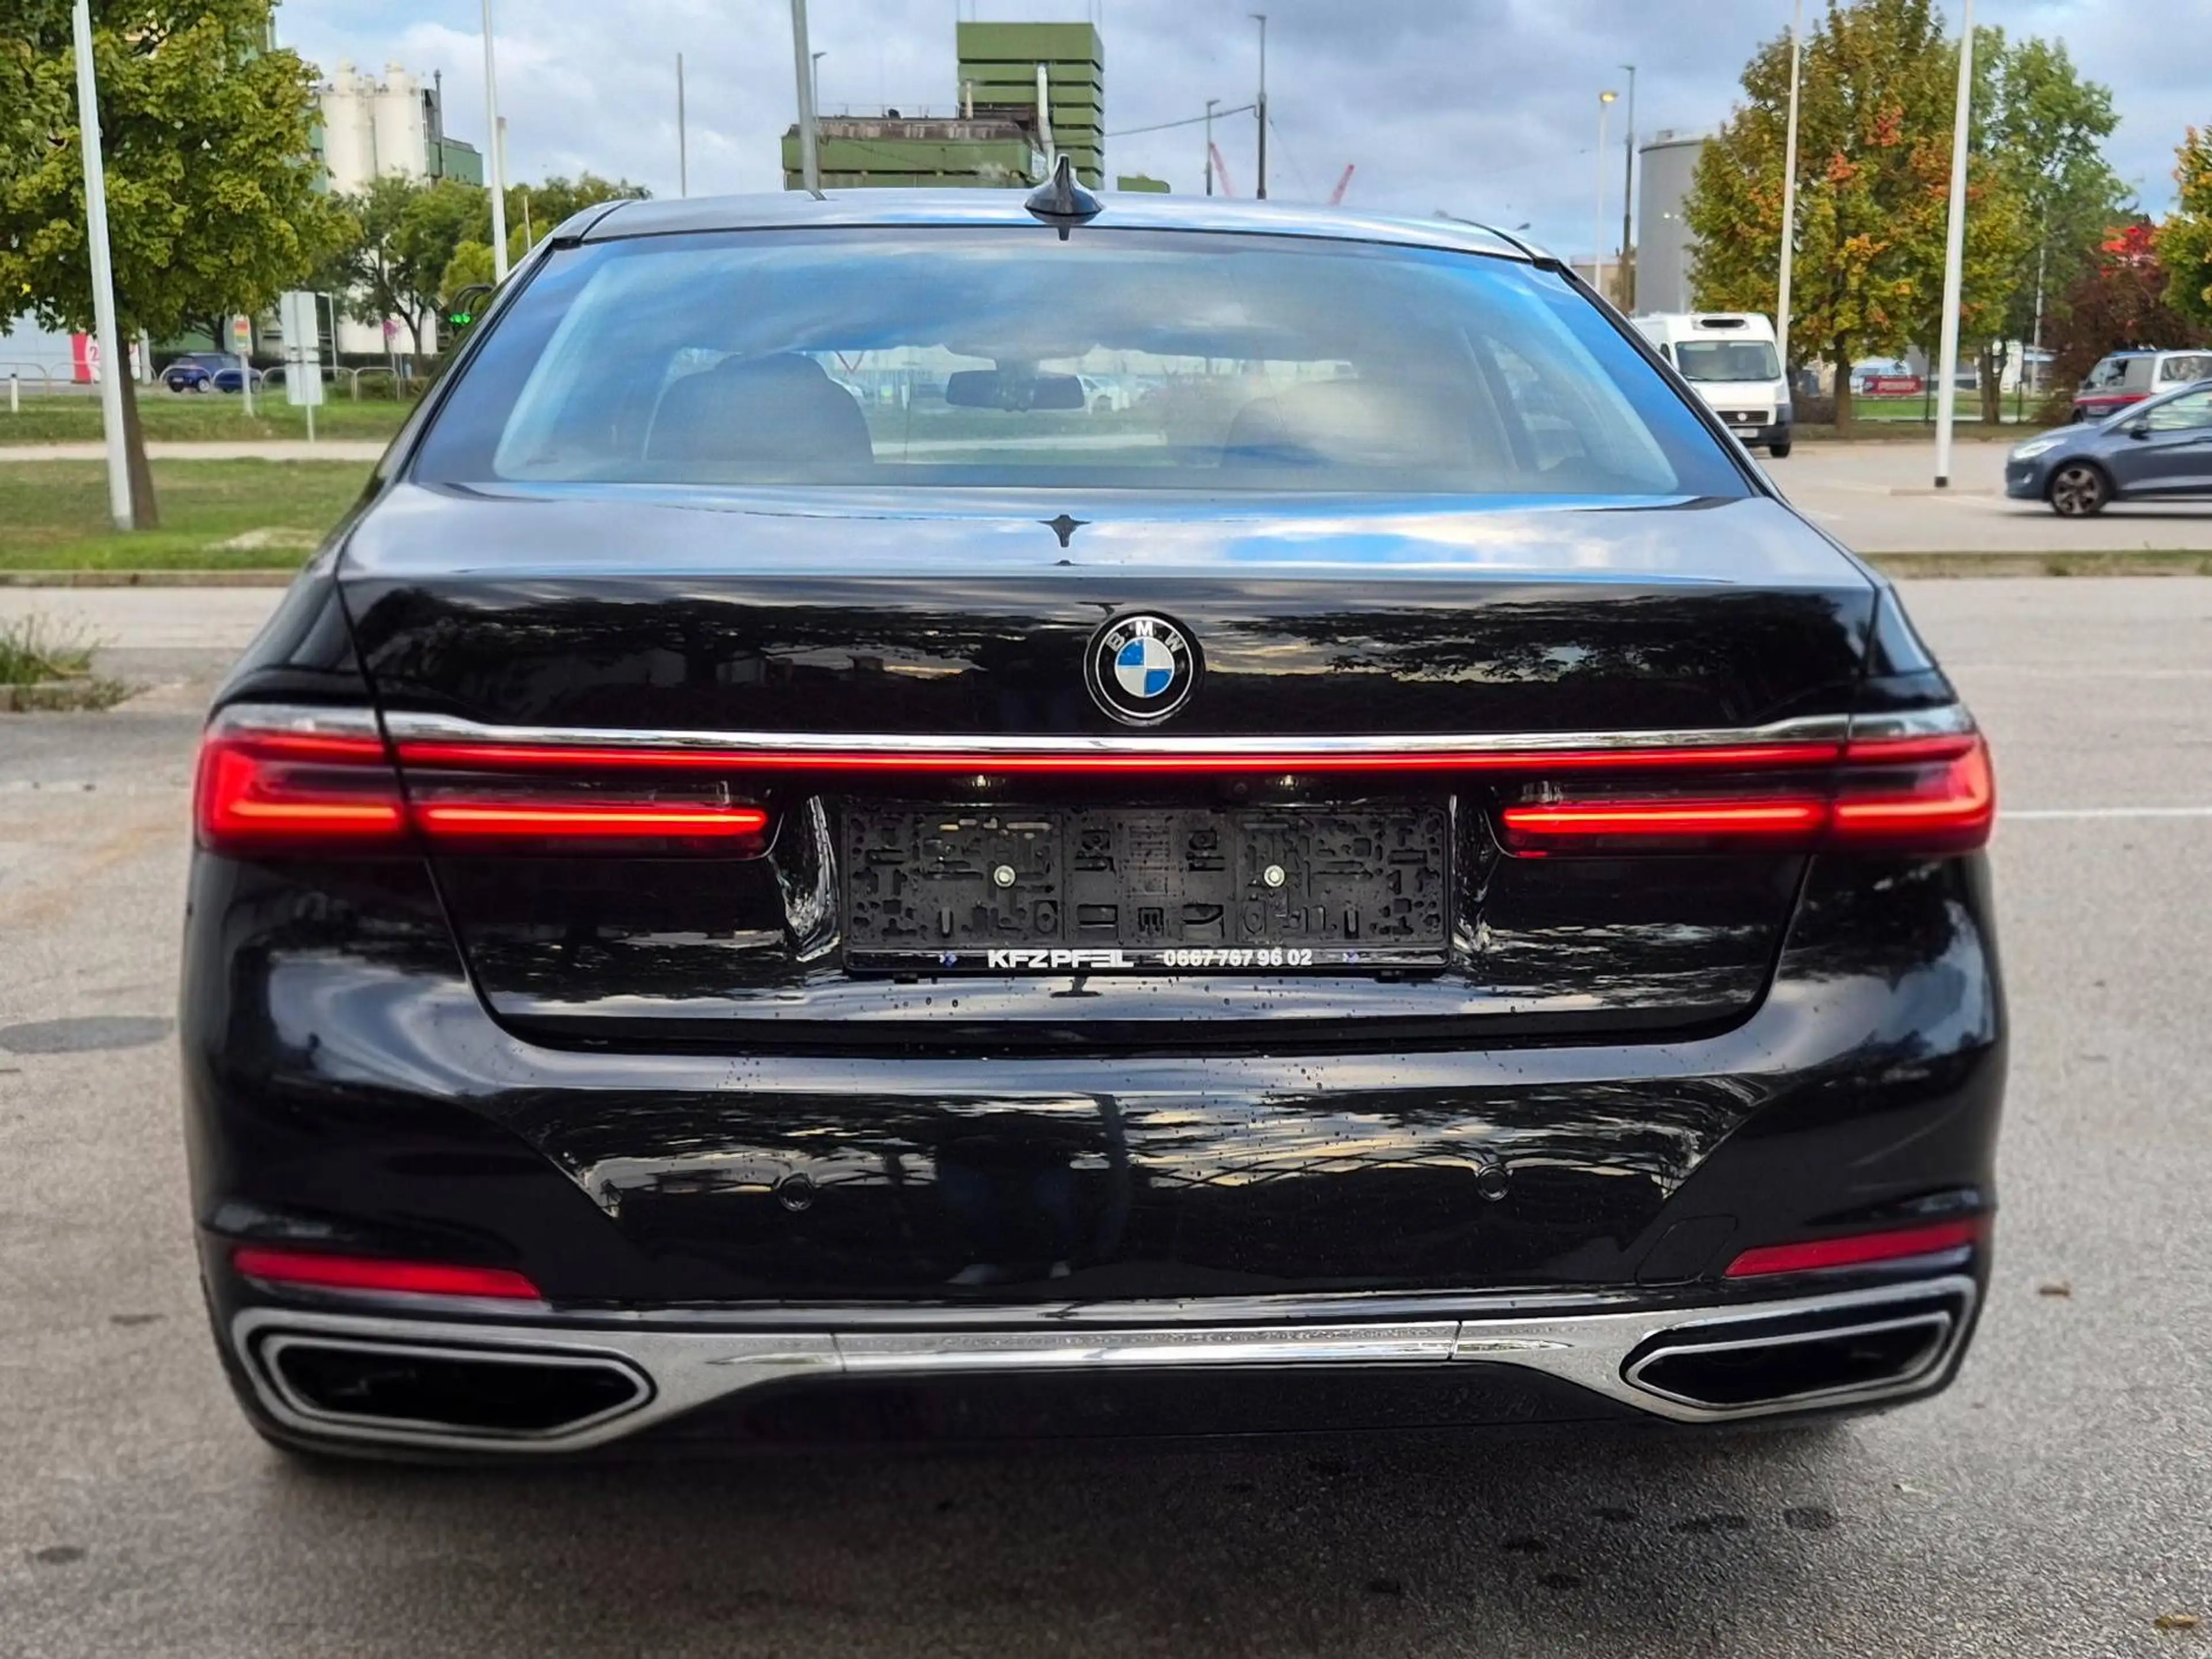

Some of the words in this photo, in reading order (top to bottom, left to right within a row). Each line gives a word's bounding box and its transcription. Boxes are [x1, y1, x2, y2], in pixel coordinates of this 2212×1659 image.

[1106, 620, 1184, 653] BMW
[1257, 948, 1282, 967] 96
[1287, 949, 1312, 966] 02
